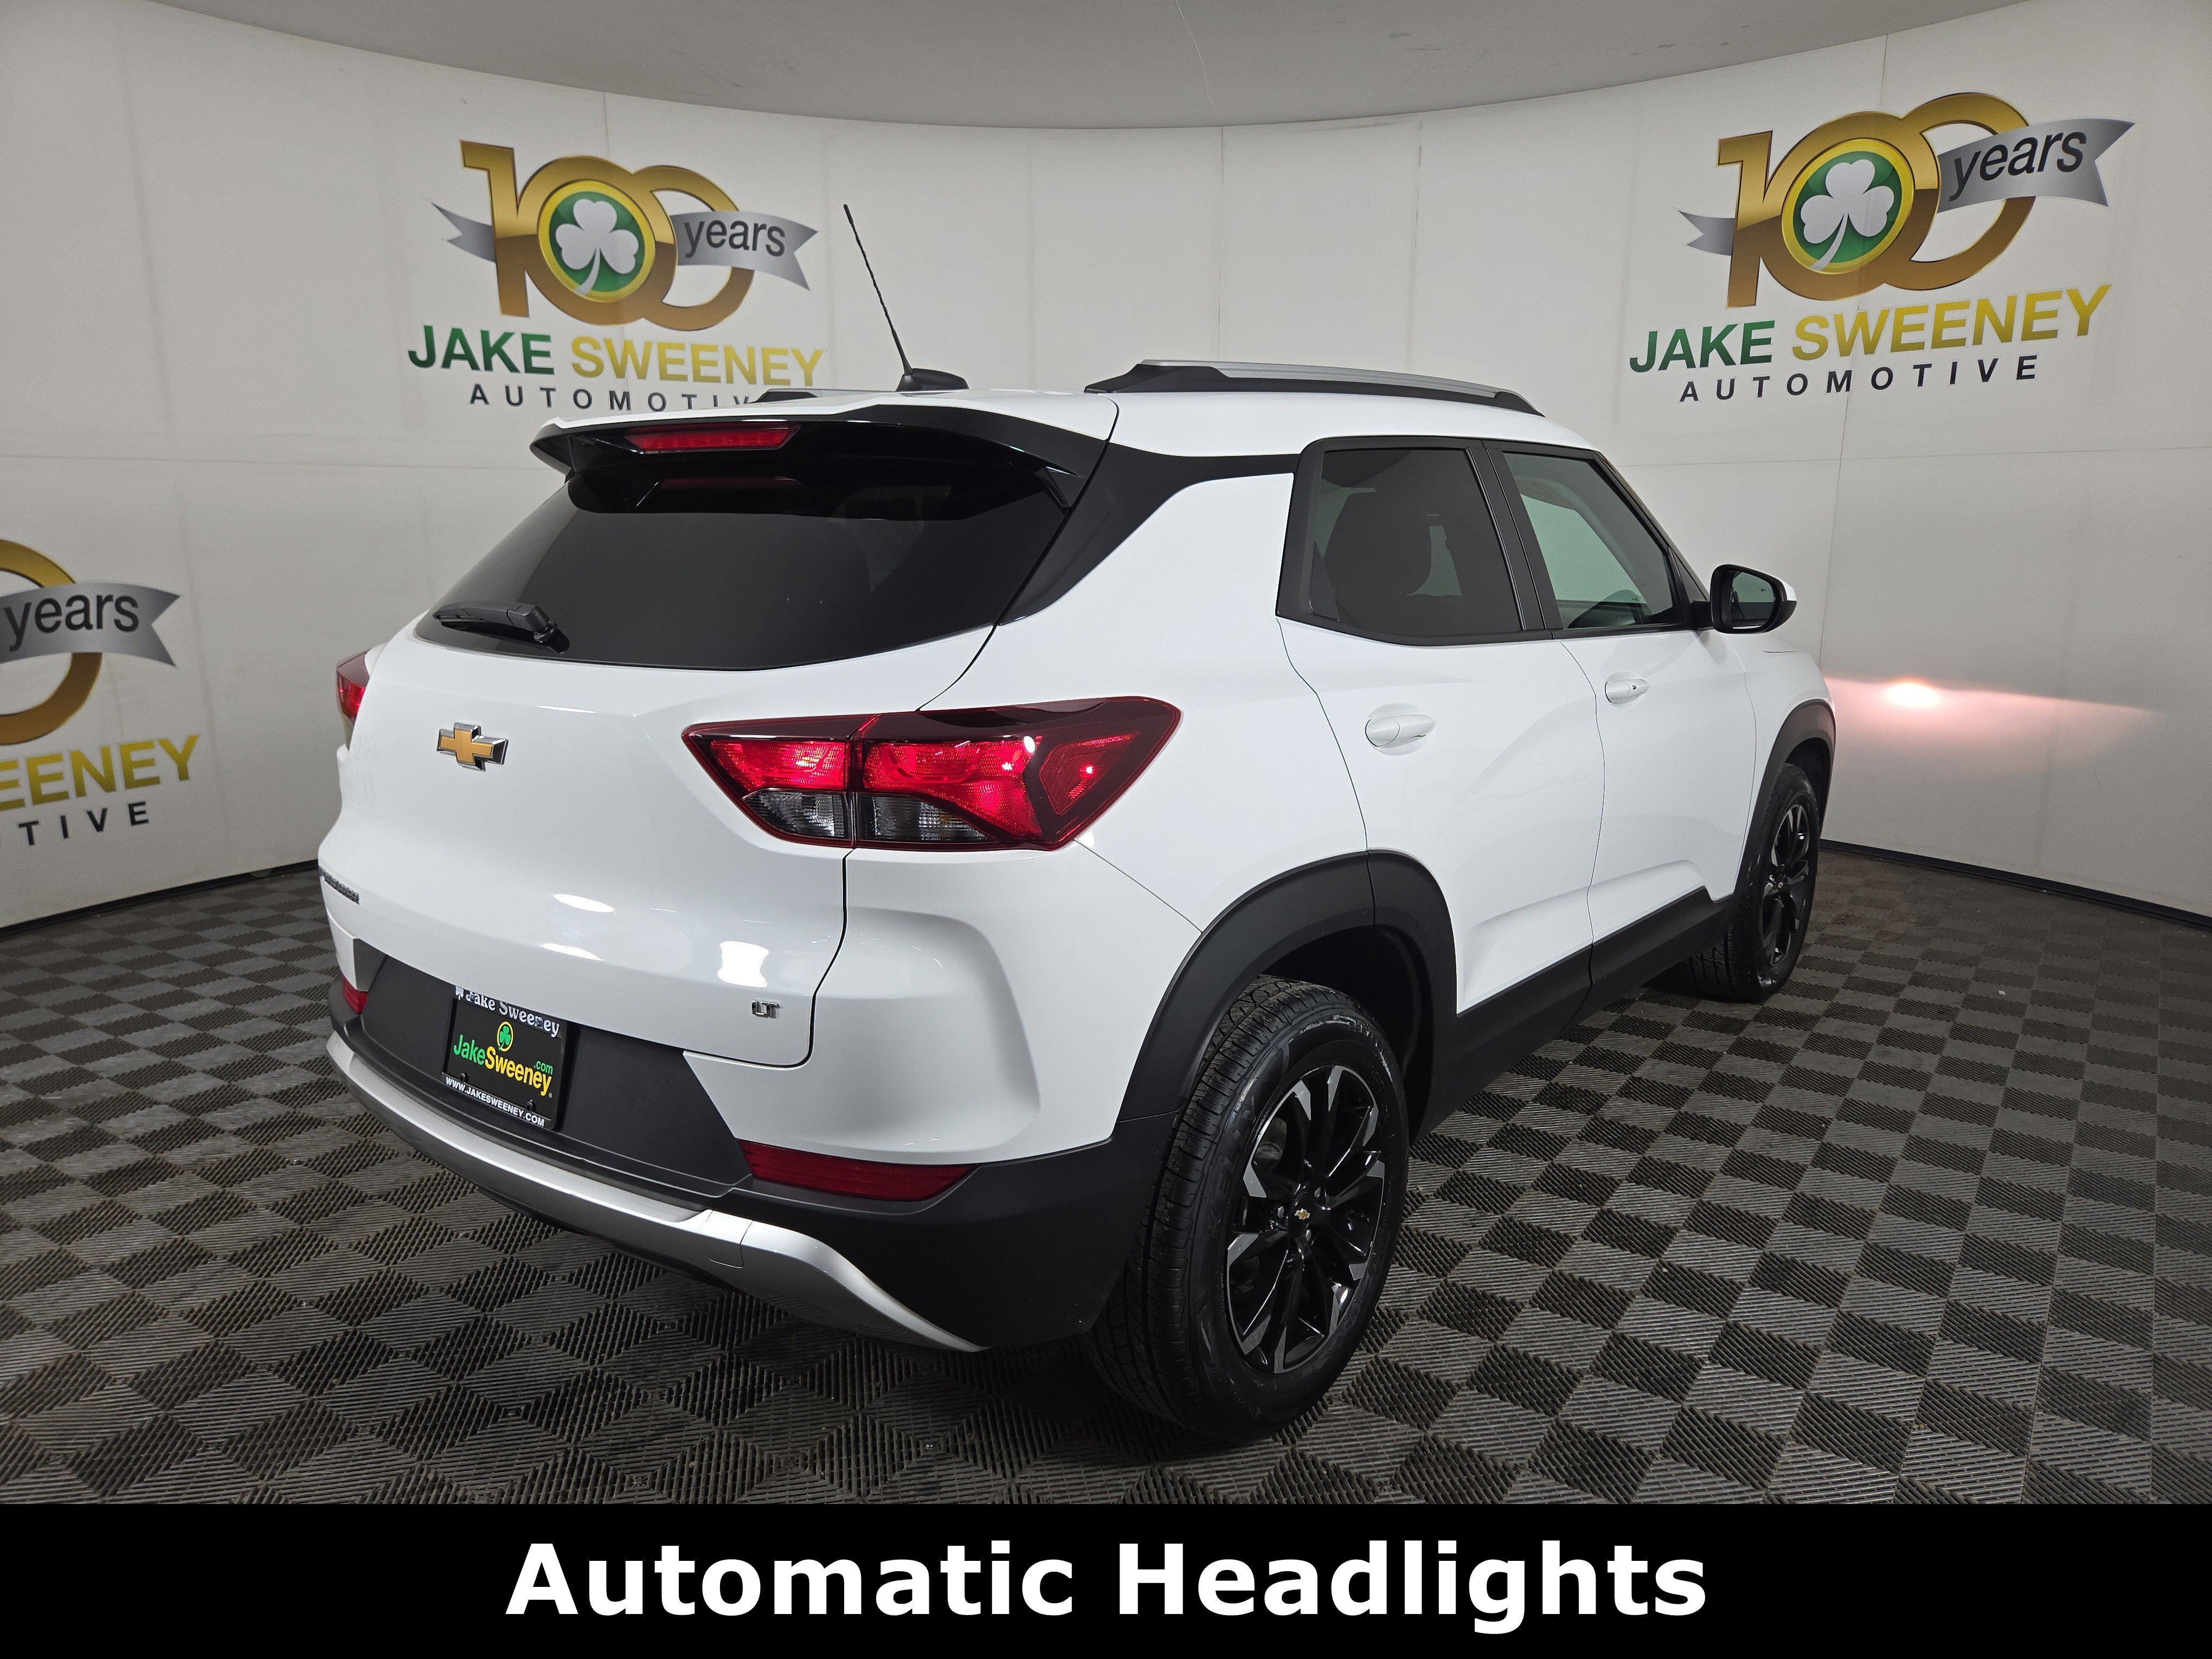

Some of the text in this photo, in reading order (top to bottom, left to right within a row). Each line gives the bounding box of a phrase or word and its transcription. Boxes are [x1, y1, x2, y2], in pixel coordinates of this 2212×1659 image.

[1949, 130, 2088, 202] years
[685, 217, 786, 258] years
[1630, 284, 2112, 372] JAKE SWEENEY
[408, 325, 824, 387] JAKE SWEENEY
[1680, 355, 2040, 402] AUTOMOTIVE
[4, 594, 139, 652] years
[499, 1001, 560, 1038] Sweeney
[751, 1000, 780, 1019] LT
[446, 1076, 545, 1127] WWW.JAKESWEENEY.COM
